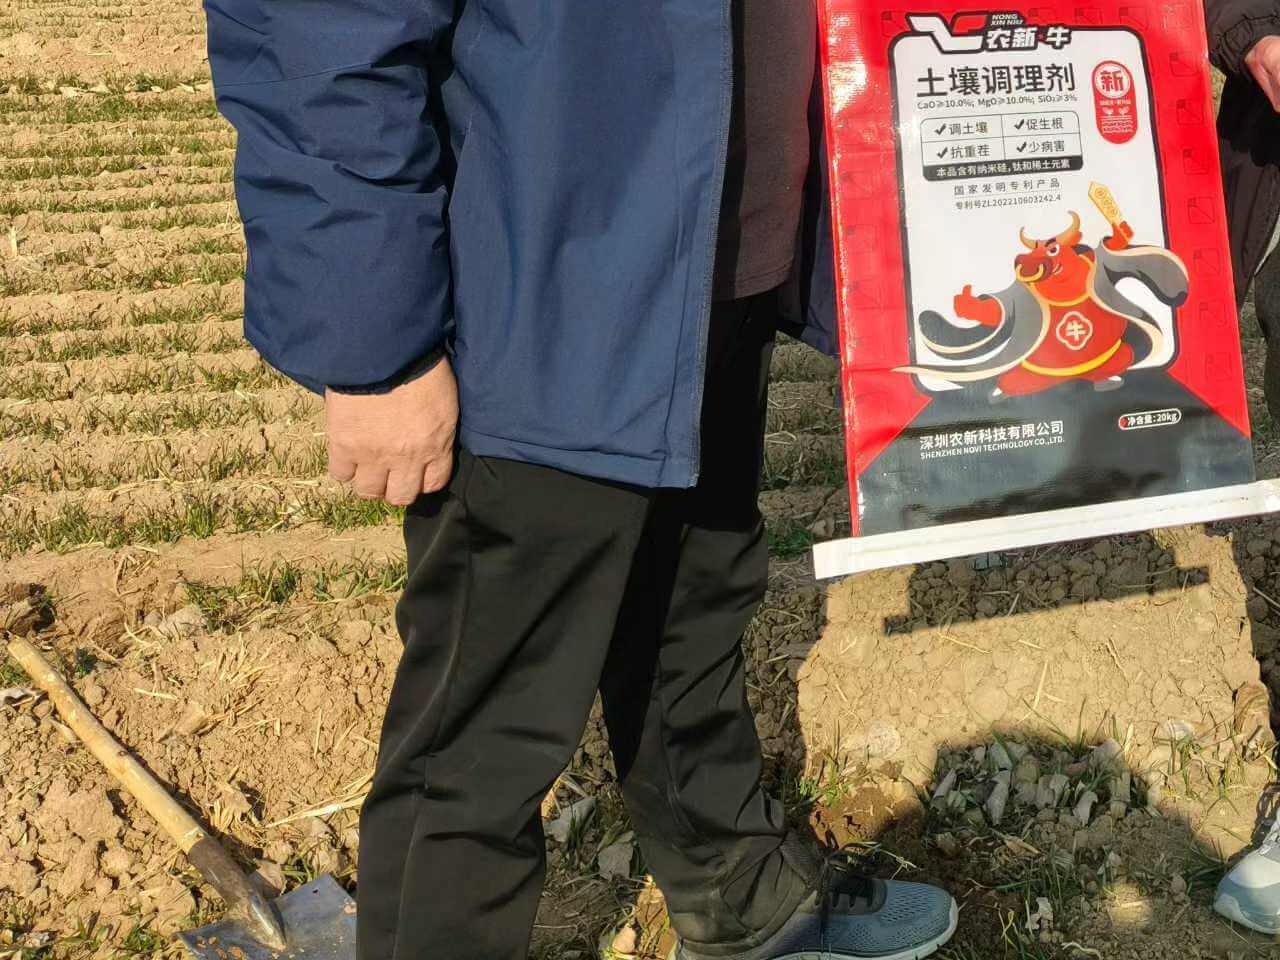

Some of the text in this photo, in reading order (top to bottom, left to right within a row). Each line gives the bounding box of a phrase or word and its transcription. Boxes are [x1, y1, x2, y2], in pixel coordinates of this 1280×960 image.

[917, 63, 1076, 98] 土壤调理剂
[1100, 70, 1124, 92] 新
[948, 122, 988, 136] 调土壤
[1026, 117, 1064, 130] 促生根
[951, 144, 991, 159] 抗重茬
[1029, 140, 1065, 153] 少病害
[1065, 319, 1086, 342] 牛
[919, 420, 1064, 451] 深圳农新科技有限公司
[920, 448, 962, 460] SHENZHEN
[963, 445, 982, 454] NOVI
[983, 439, 1034, 452] TECHNOLOGY
